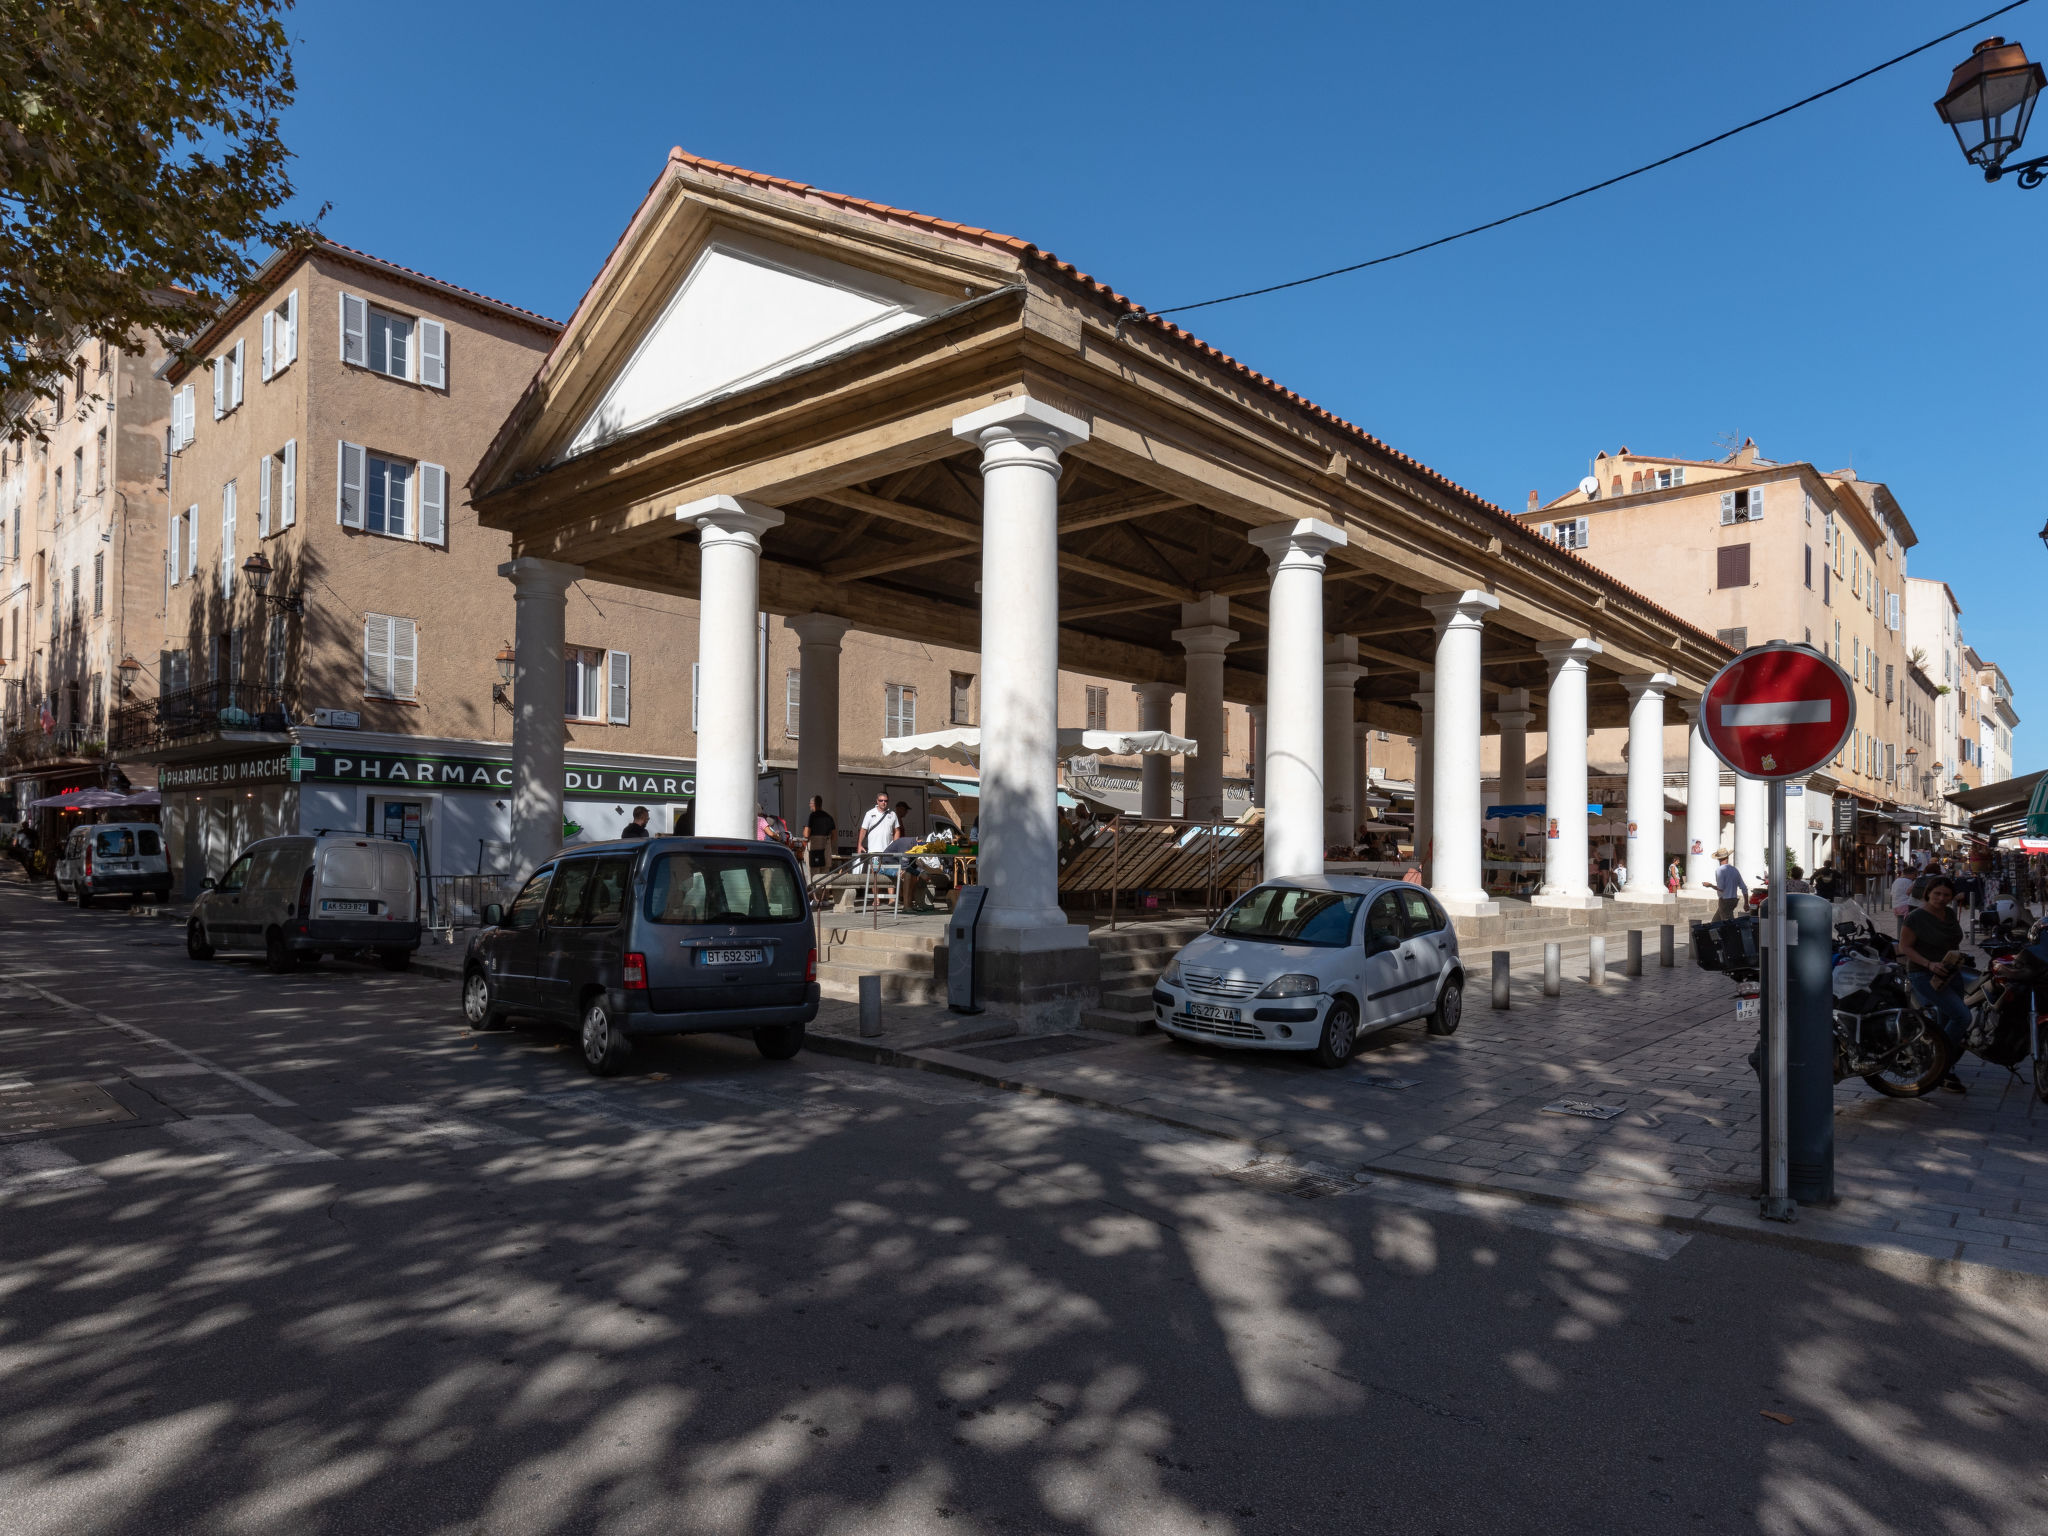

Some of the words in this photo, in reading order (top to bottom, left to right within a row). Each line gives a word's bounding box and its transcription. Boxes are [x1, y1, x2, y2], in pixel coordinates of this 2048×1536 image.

[167, 765, 219, 786] PHARMACIE
[223, 763, 236, 780] DU
[240, 754, 287, 779] MARCHÉ
[334, 758, 512, 785] PHARMAC
[565, 772, 602, 789] DU
[619, 776, 695, 799] MARC
[707, 951, 757, 962] BT-692-SH
